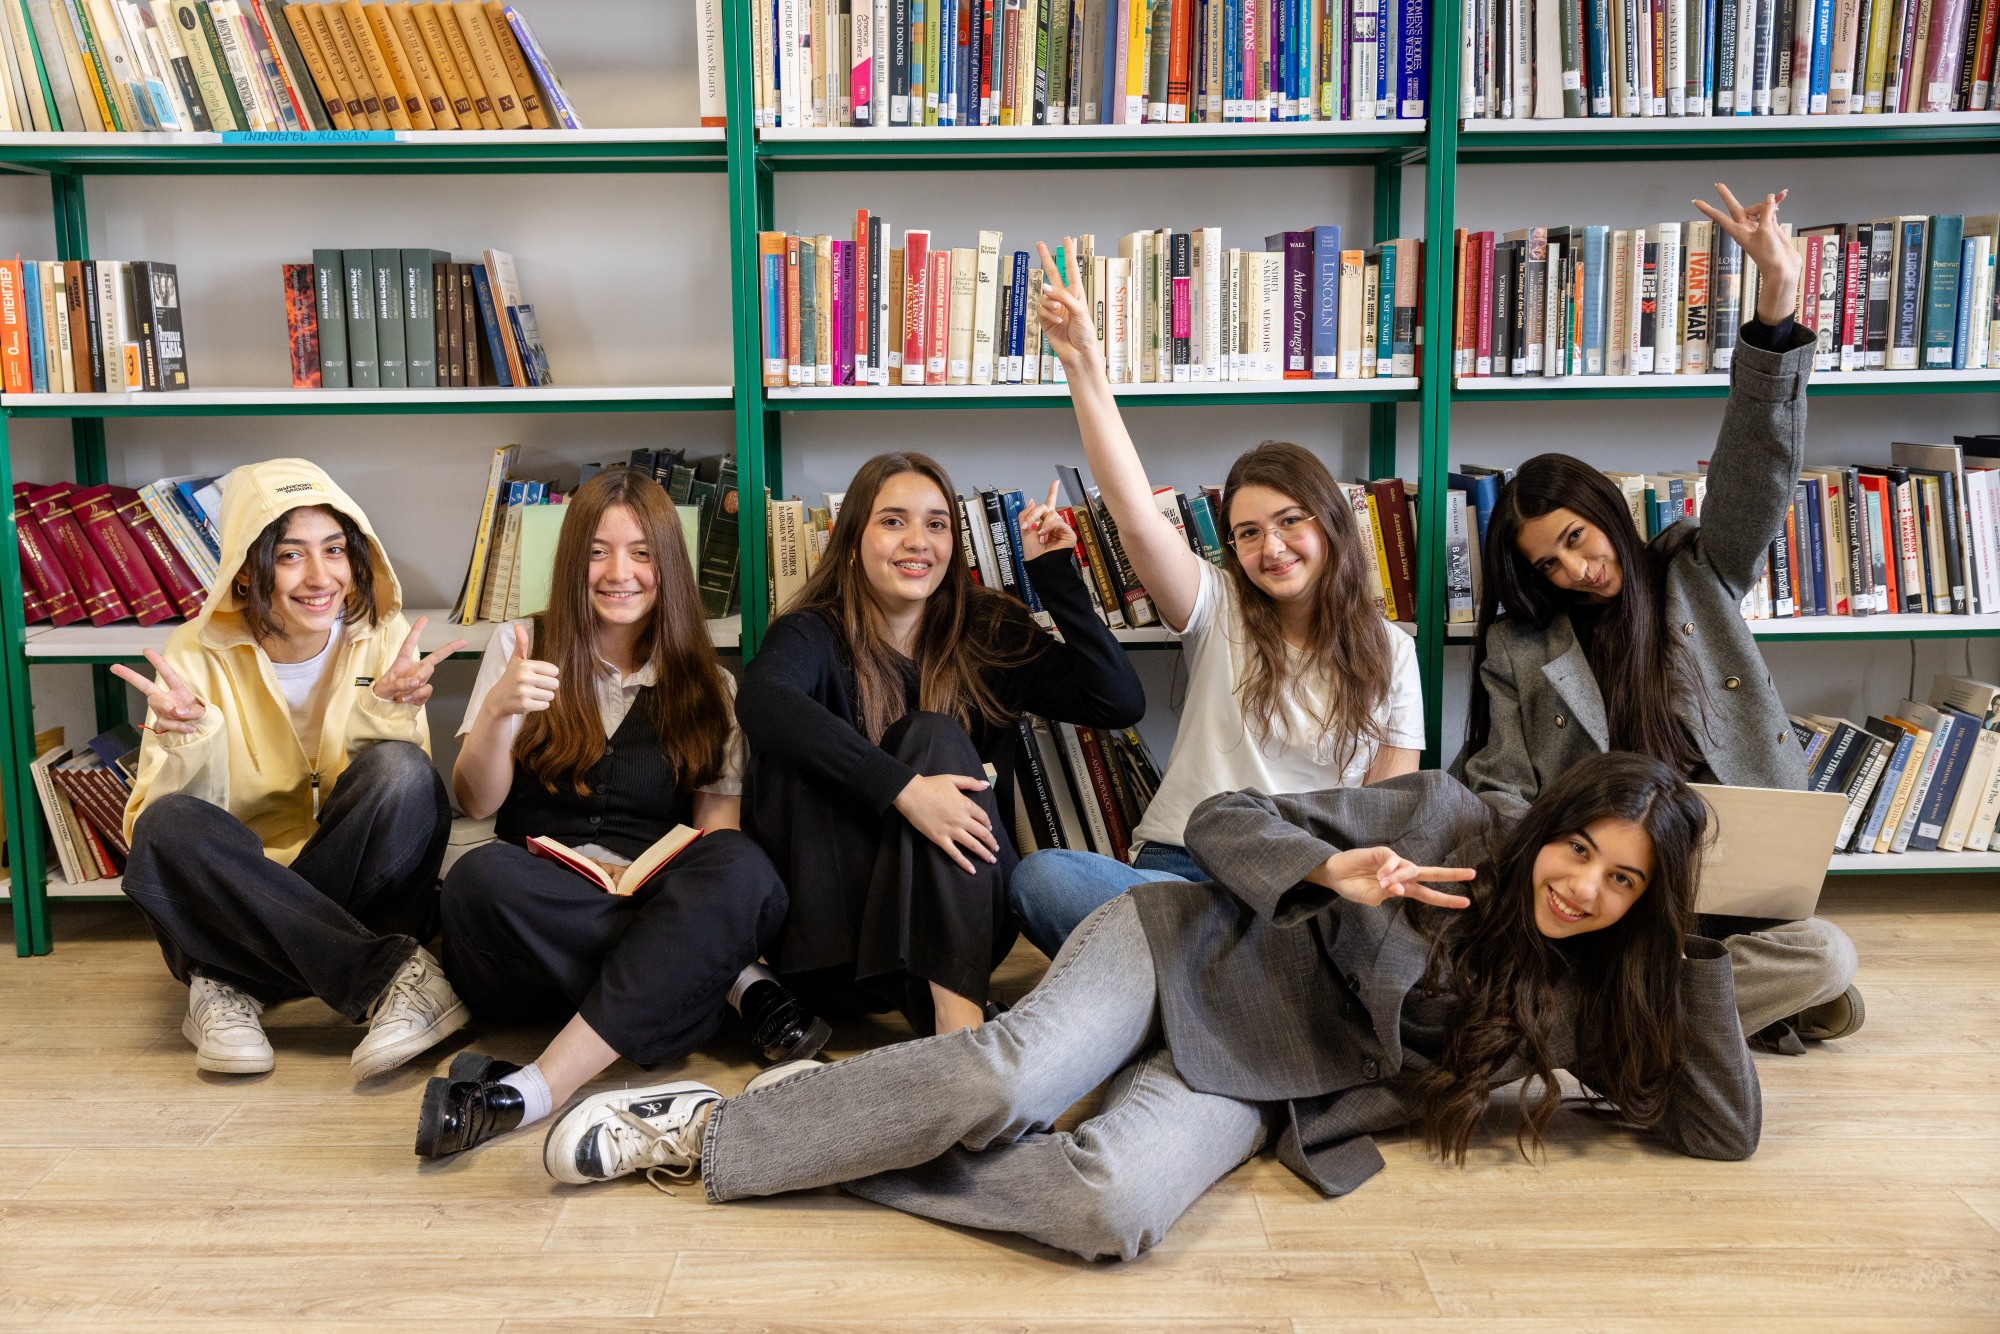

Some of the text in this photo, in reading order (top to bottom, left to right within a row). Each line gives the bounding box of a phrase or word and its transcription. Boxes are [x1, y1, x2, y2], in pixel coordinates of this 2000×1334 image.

[1053, 0, 1061, 29] BROWN
[1244, 0, 1255, 50] REACTIONS
[1380, 19, 1385, 29] BY
[1670, 5, 1676, 15] OF
[1820, 9, 1829, 45] STARTUP
[217, 19, 234, 46] СКАЗКИ
[296, 20, 319, 64] ПУШКИН
[316, 20, 339, 64] ПУШКИН
[334, 18, 357, 62] ПУШКИН
[354, 17, 376, 61] ПУШКИН
[786, 31, 792, 39] OF
[877, 16, 885, 52] PHILANTHROPY
[1120, 45, 1125, 53] OF
[1962, 13, 1979, 94] LITERARY THEORY
[236, 77, 256, 110] РАССКАЗЫ
[318, 131, 370, 140] RUSSIAN
[0, 267, 16, 324] ШПЕНГЛЕР
[1271, 259, 1279, 293] ANDREI
[1321, 262, 1335, 327] LINCOLN
[1498, 274, 1506, 318] KHORENICA
[1846, 253, 1857, 314] ORDINARY MEN
[1112, 287, 1127, 343] Sapiens
[1289, 269, 1306, 356] Andrew Carnegie
[1613, 246, 1625, 351] THE COLD WAR IN EUROPE
[1687, 252, 1709, 341] IVAN'S WAR
[1901, 252, 1917, 346] EUROPE IN OUR TIME
[913, 319, 918, 333] OF
[1263, 308, 1271, 353] MEMOIRS
[275, 483, 312, 493] GEOGRAPHIC
[778, 506, 786, 535] BARBARA
[780, 536, 787, 544] W.
[786, 512, 795, 544] DISTANT
[1849, 509, 1857, 537] Crime
[1901, 516, 1910, 553] TRAGEDY
[1908, 515, 1916, 553] ARMENIAN
[789, 545, 797, 576] MIRROR
[990, 522, 1014, 586] EDUARD SHEVARDNADZE
[1393, 513, 1405, 558] Azerbaijan
[1400, 558, 1410, 581] Diary
[1851, 537, 1858, 547] of
[1452, 546, 1462, 598] BALKANS
[1852, 548, 1862, 592] Vengeance
[1833, 728, 1856, 760] PARTING
[1870, 741, 1883, 756] WHO
[1029, 760, 1039, 776] ЧТО
[1034, 776, 1047, 802] ТАКОЕ
[1091, 758, 1113, 813] ANTHROPOLOGY
[1825, 759, 1839, 776] THE
[1860, 757, 1873, 776] OWNS
[1871, 736, 1911, 831] THEA HALO NOT EVEN MY NAME
[1913, 720, 1950, 811] AMERICA AGAINST THE WORLD
[1930, 727, 1966, 821] THE GREAT UPHEAVAL JAY WINIK
